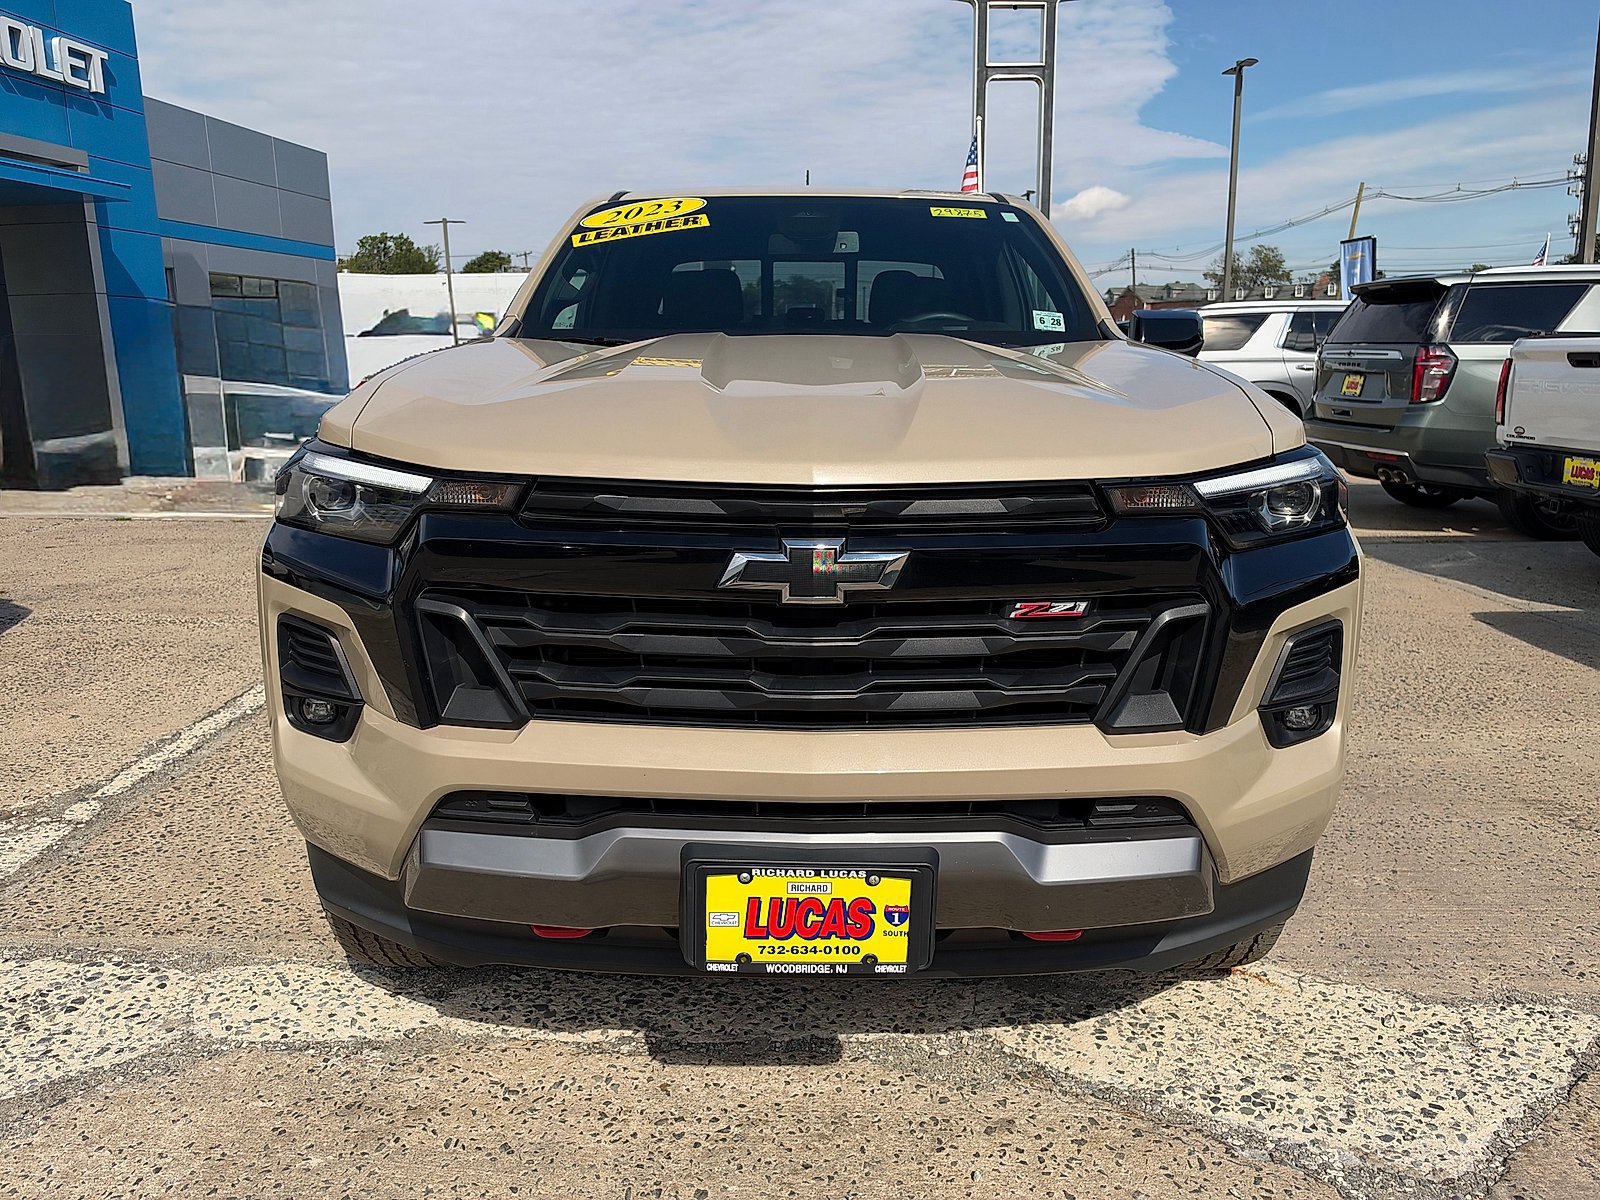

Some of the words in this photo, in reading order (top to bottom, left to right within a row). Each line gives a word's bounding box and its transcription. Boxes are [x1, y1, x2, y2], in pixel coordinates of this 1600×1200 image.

[602, 200, 683, 225] 2023
[578, 216, 701, 244] LEATHER
[1039, 316, 1046, 325] 6
[1050, 317, 1062, 327] 28
[1570, 465, 1595, 480] LUCAS
[1009, 601, 1088, 619] Z71
[751, 868, 815, 878] RICHARD
[820, 870, 867, 878] LUCAS
[790, 884, 828, 893] RICHARD
[744, 896, 877, 940] LUCAS
[891, 912, 901, 925] 1
[757, 945, 861, 955] 732-634-0100
[706, 963, 739, 972] CHEVROLET
[765, 963, 833, 974] WOODBRIDGE,
[835, 964, 848, 974] NJ
[874, 964, 907, 973] CHEVROLET
